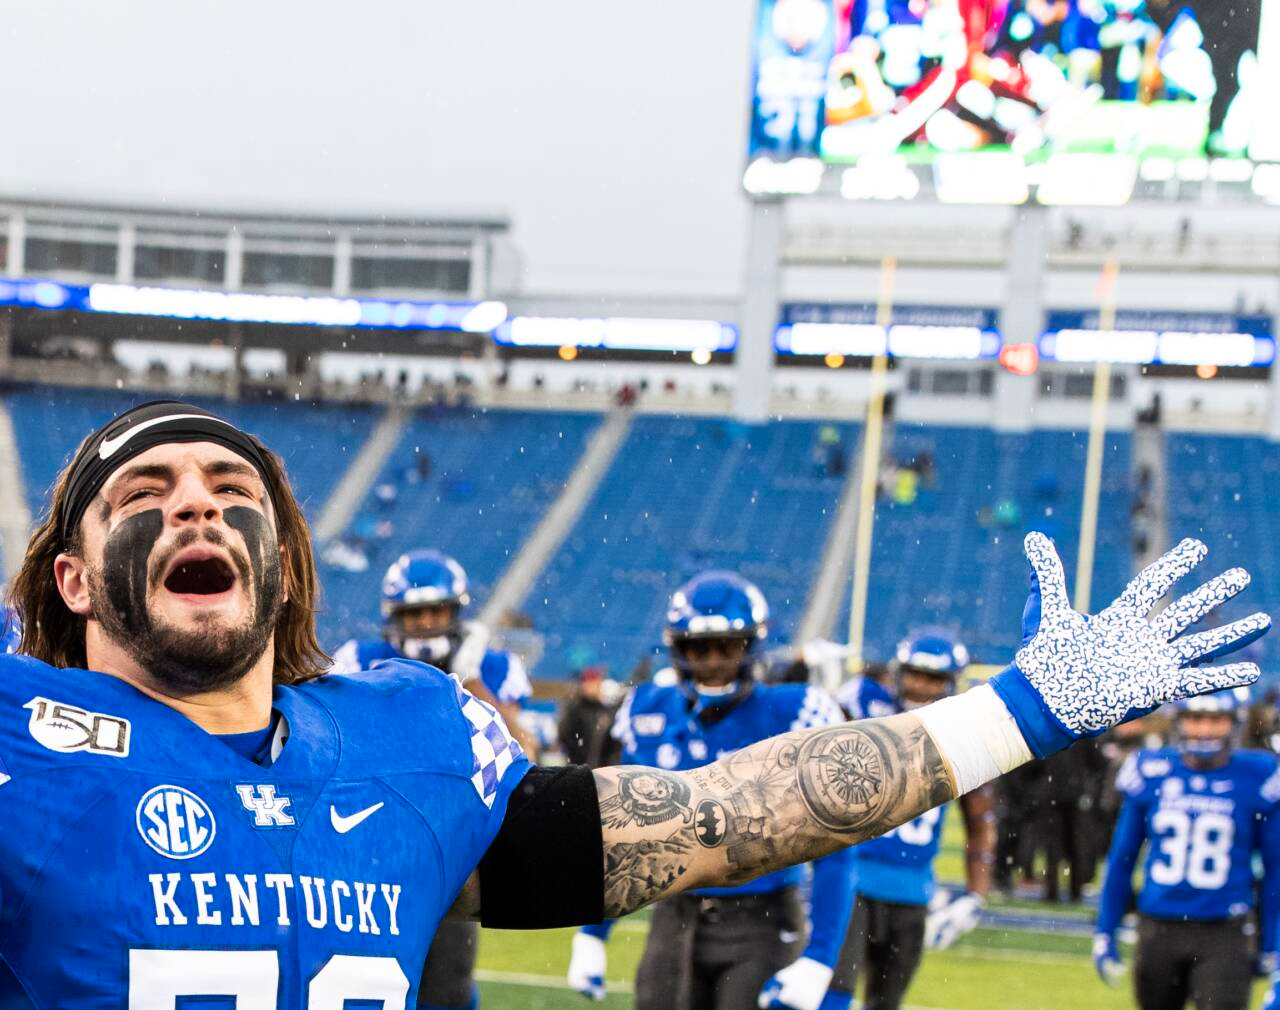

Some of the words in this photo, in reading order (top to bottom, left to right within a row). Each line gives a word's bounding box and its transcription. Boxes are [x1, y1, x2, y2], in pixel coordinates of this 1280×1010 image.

[32, 699, 128, 754] 150
[142, 789, 208, 855] SEC
[236, 784, 295, 826] UK
[1151, 809, 1236, 890] 38
[149, 872, 402, 936] KENTUCKY
